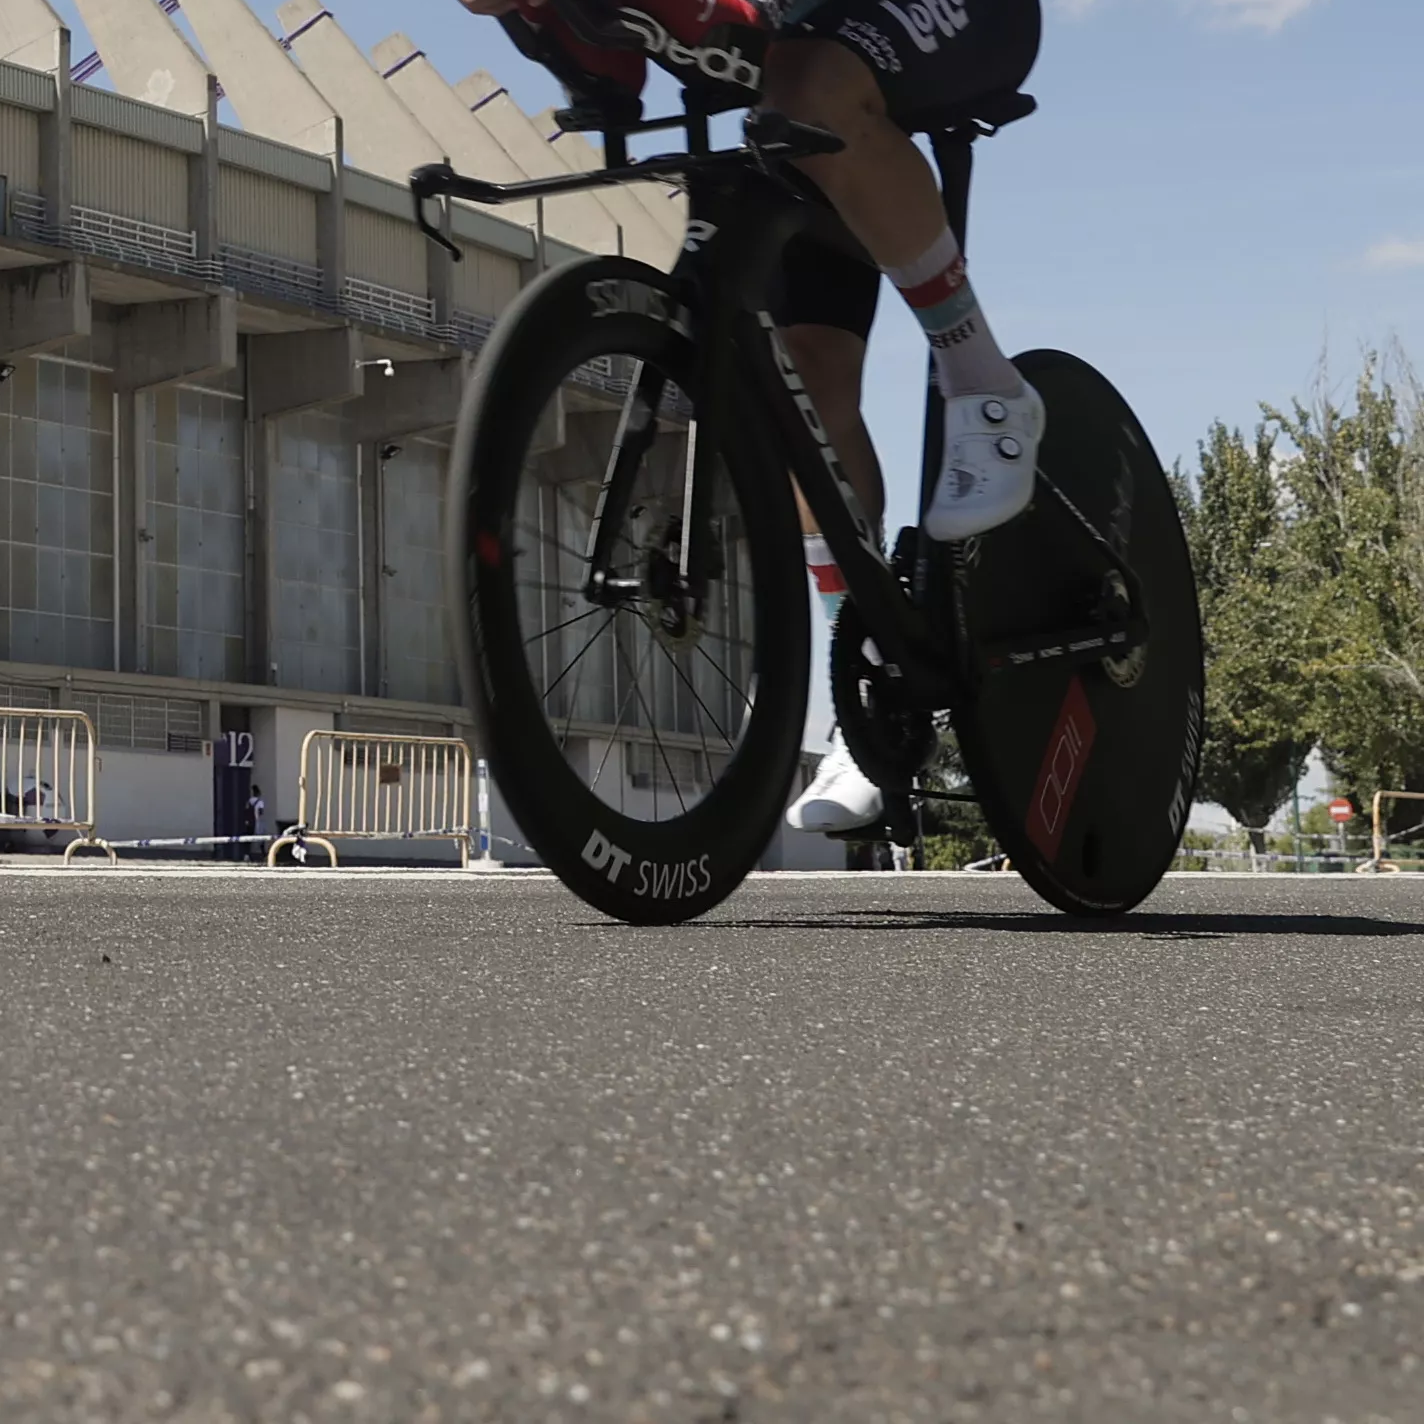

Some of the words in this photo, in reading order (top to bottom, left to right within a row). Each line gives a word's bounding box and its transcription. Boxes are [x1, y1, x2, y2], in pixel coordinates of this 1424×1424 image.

[228, 731, 254, 767] 12
[581, 828, 632, 884] DT
[633, 853, 711, 901] SWISS
